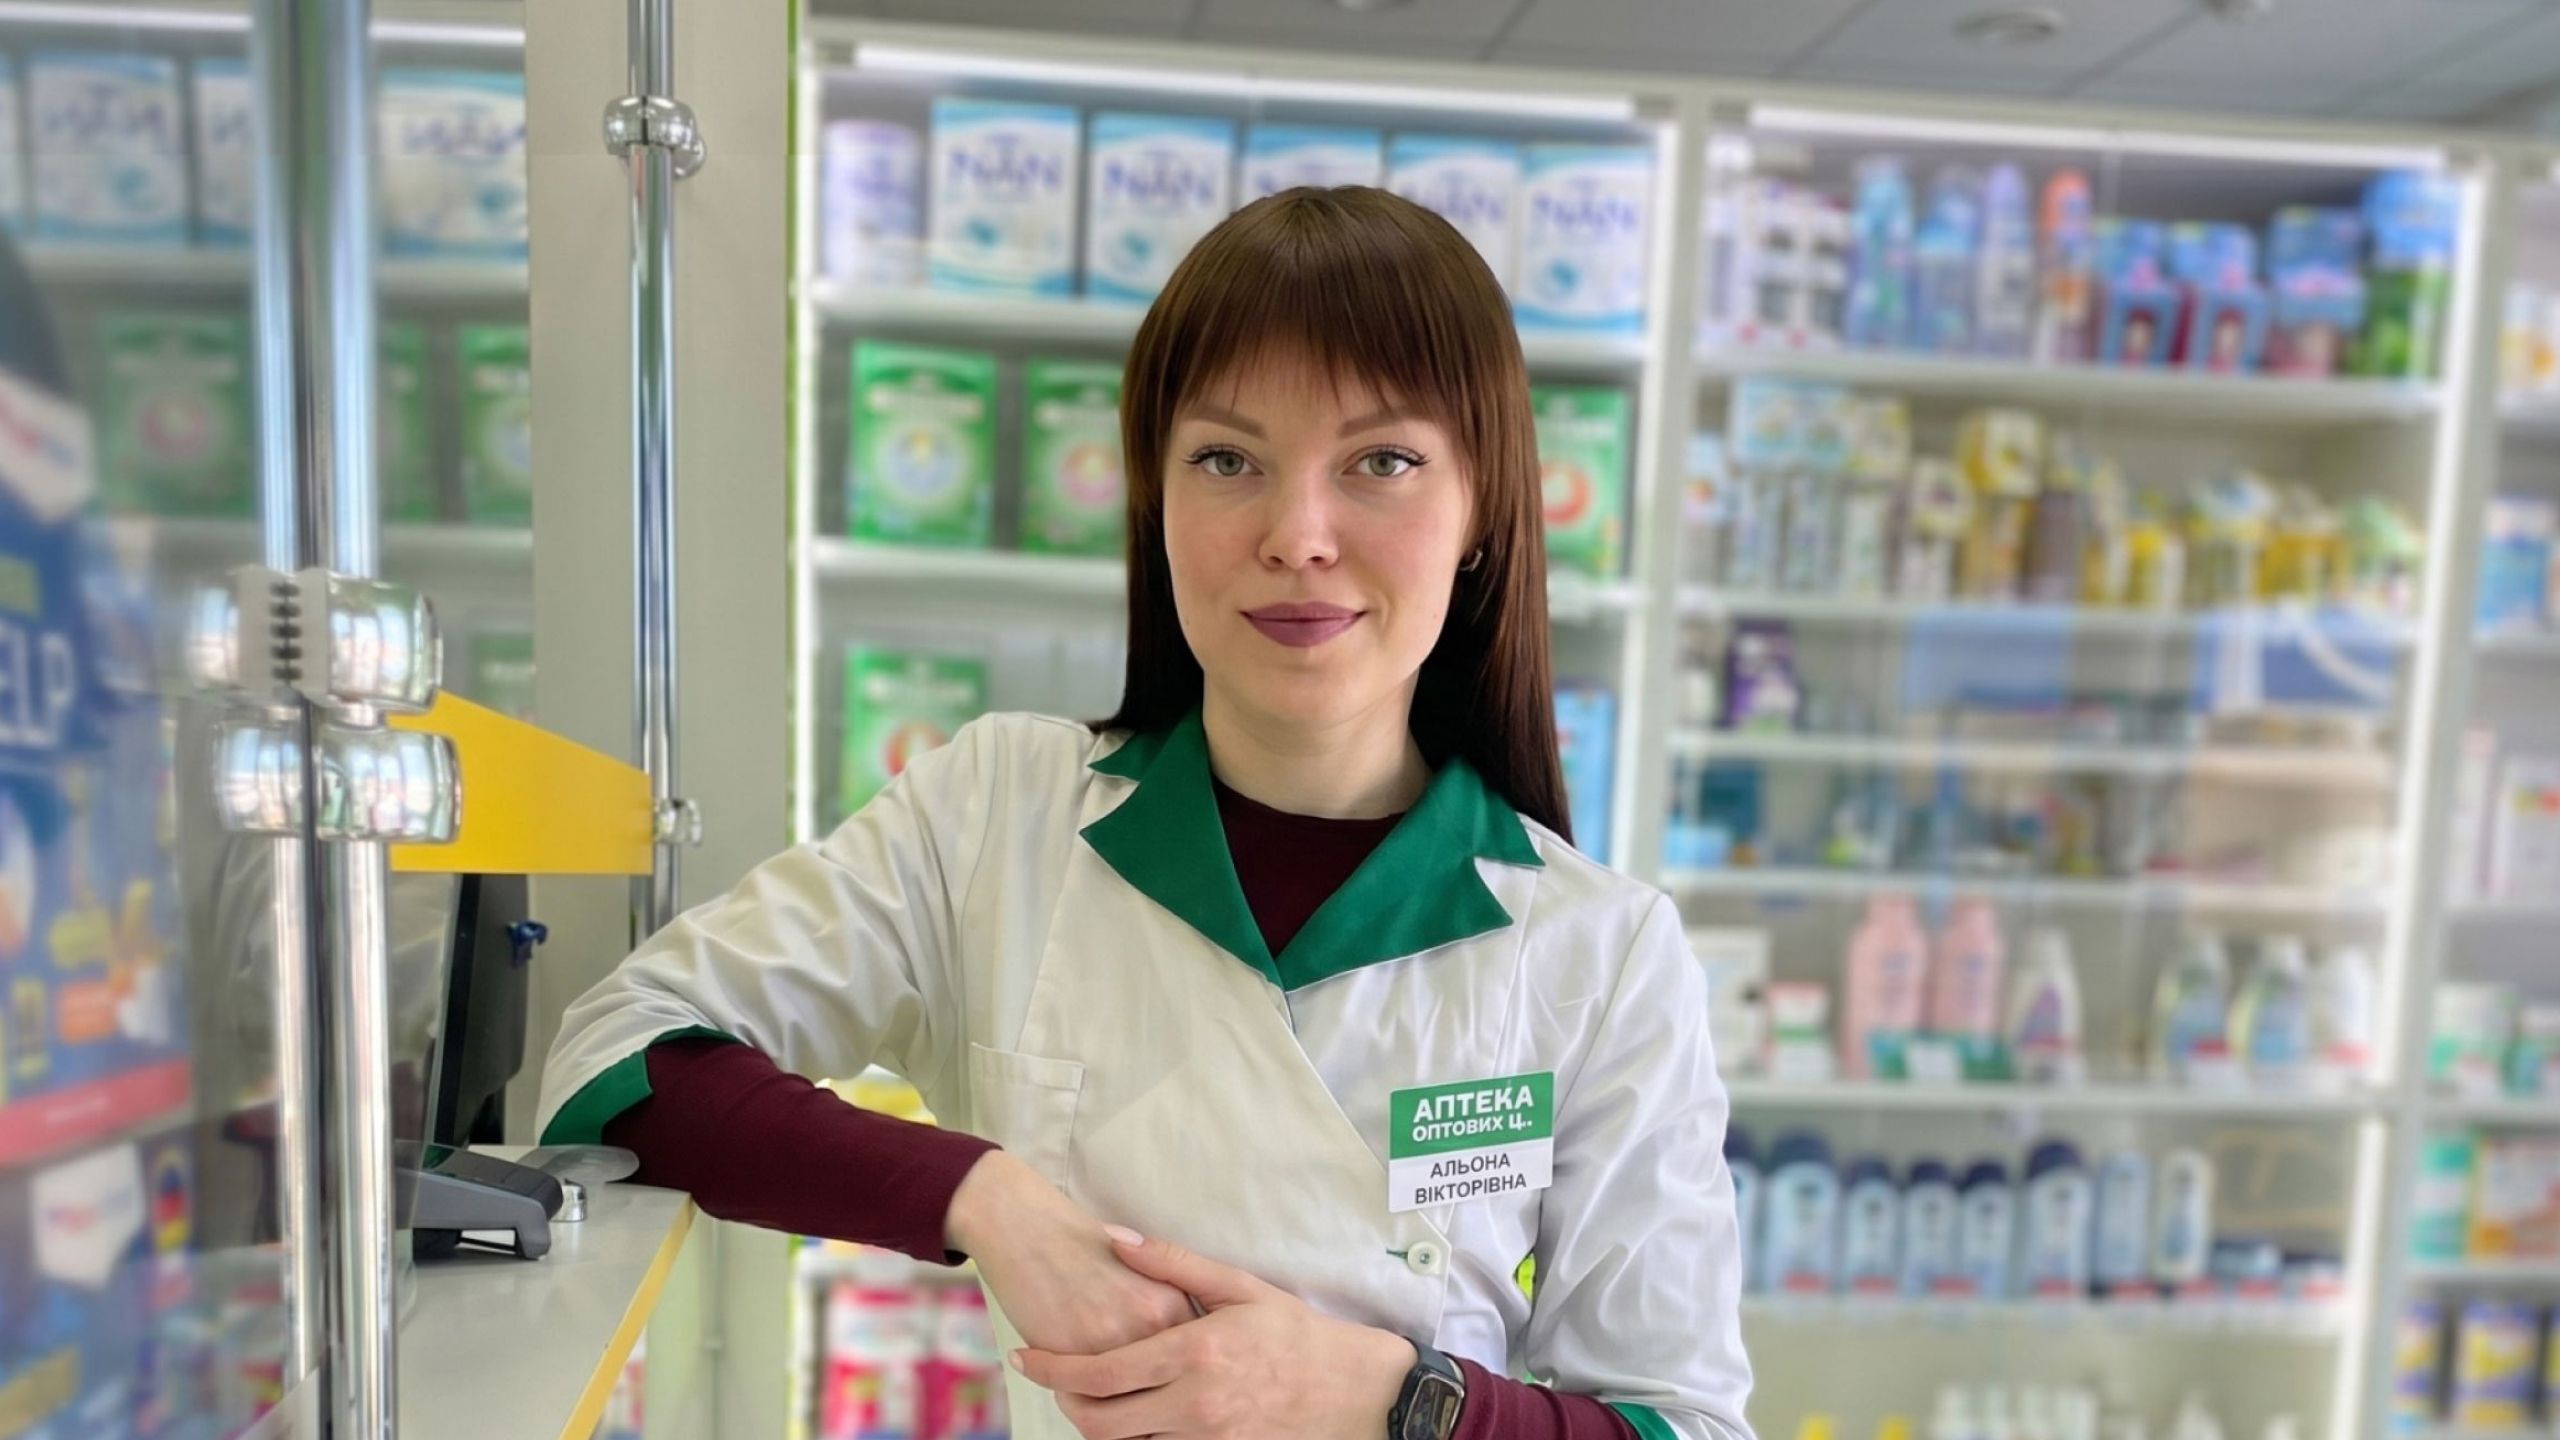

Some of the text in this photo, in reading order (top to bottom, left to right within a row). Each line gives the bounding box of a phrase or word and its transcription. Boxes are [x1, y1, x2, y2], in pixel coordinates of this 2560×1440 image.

[948, 145, 1063, 190] NAN
[1102, 155, 1215, 204] NAN
[1531, 188, 1640, 233] NAN
[1413, 1085, 1534, 1123] АПТЕКА
[1412, 1112, 1533, 1142] ОПТОВИХ Ц..
[1430, 1152, 1511, 1179] АЛЬОНА
[1415, 1173, 1527, 1205] ВІКТОРІВНА
